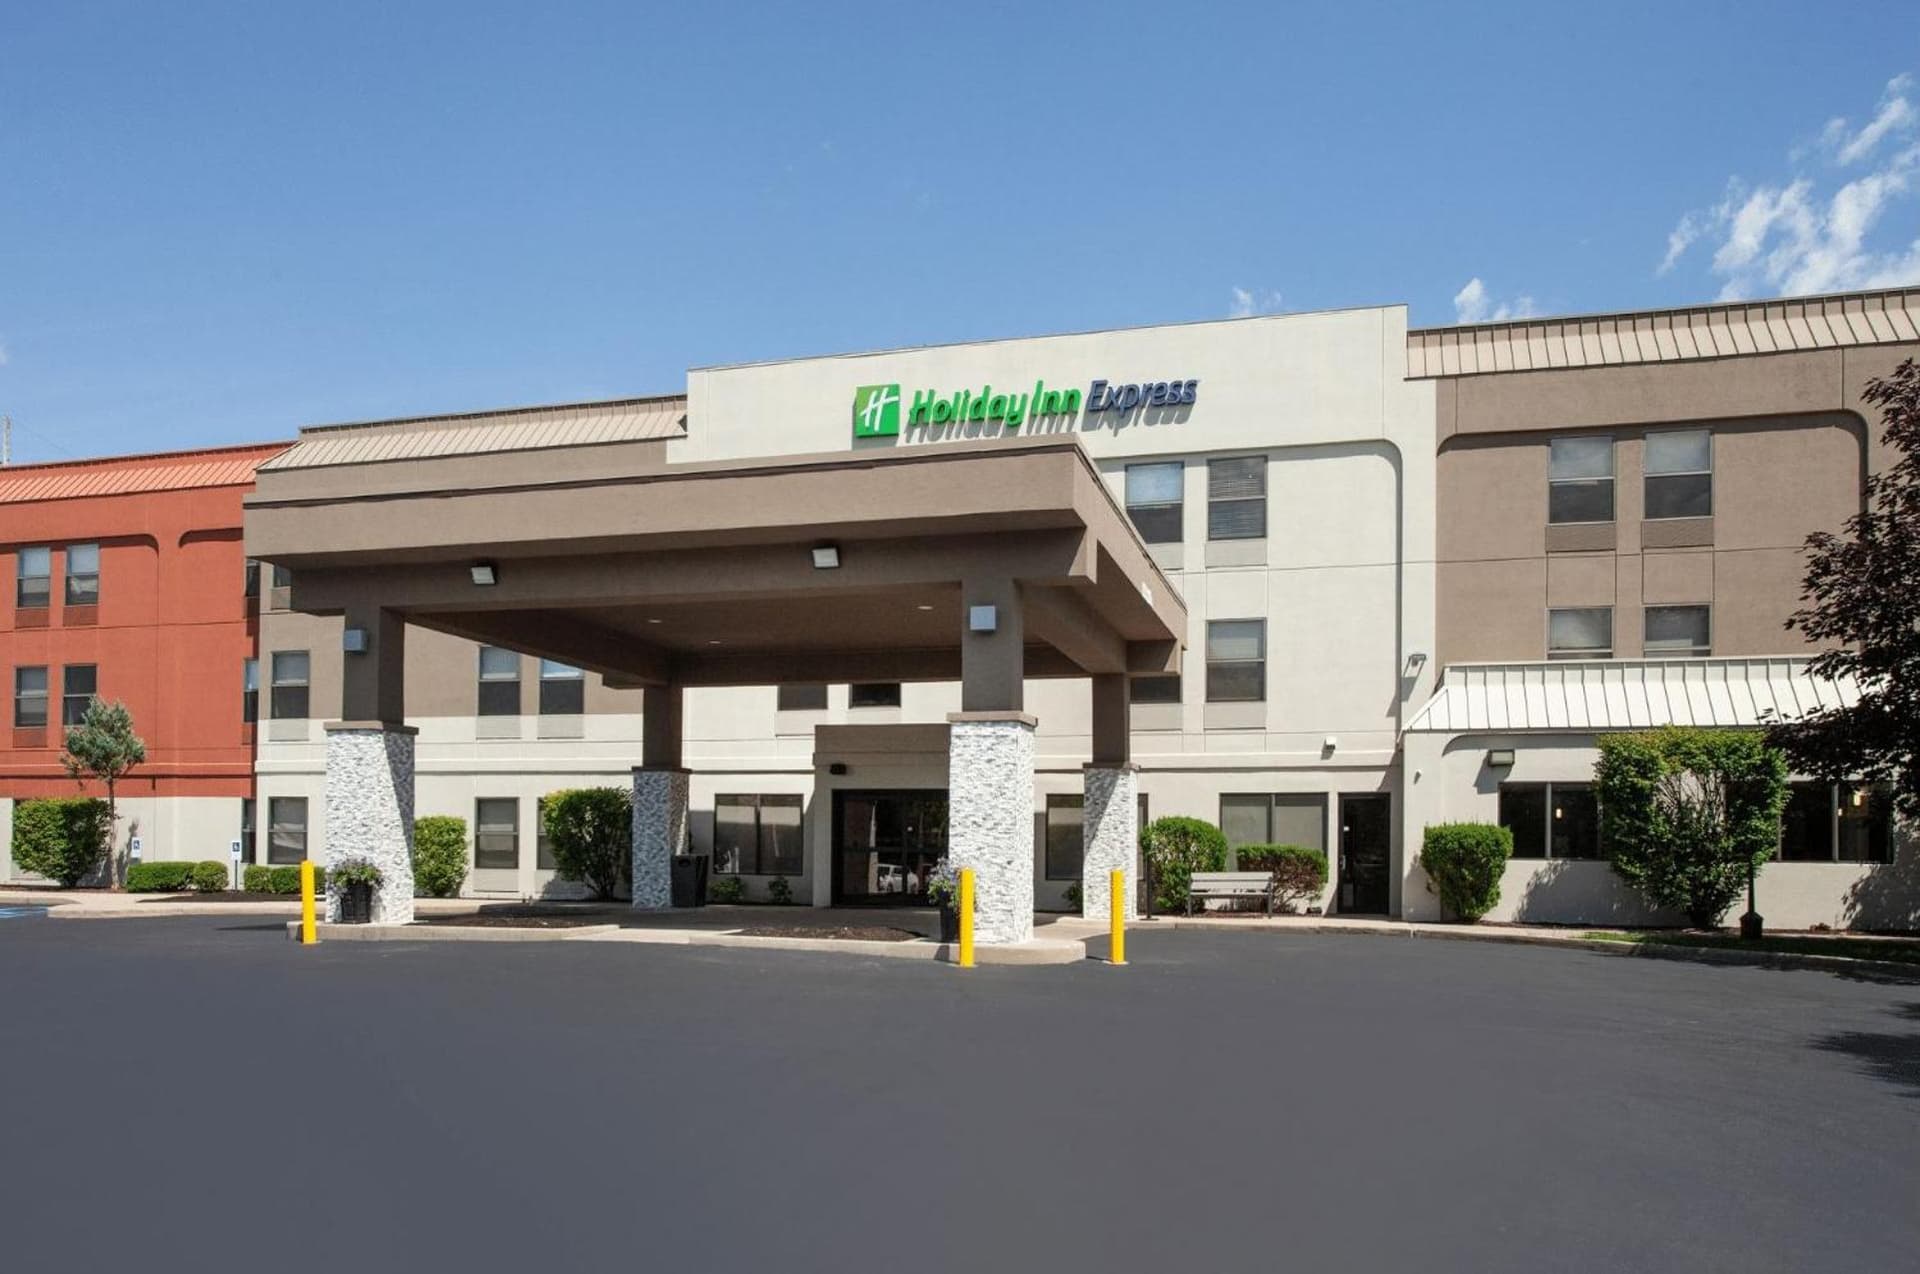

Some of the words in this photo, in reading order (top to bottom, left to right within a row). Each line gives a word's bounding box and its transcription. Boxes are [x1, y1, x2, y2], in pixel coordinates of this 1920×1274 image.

[909, 385, 1028, 426] Holiday
[1031, 380, 1082, 416] Inn
[1087, 379, 1198, 417] Express
